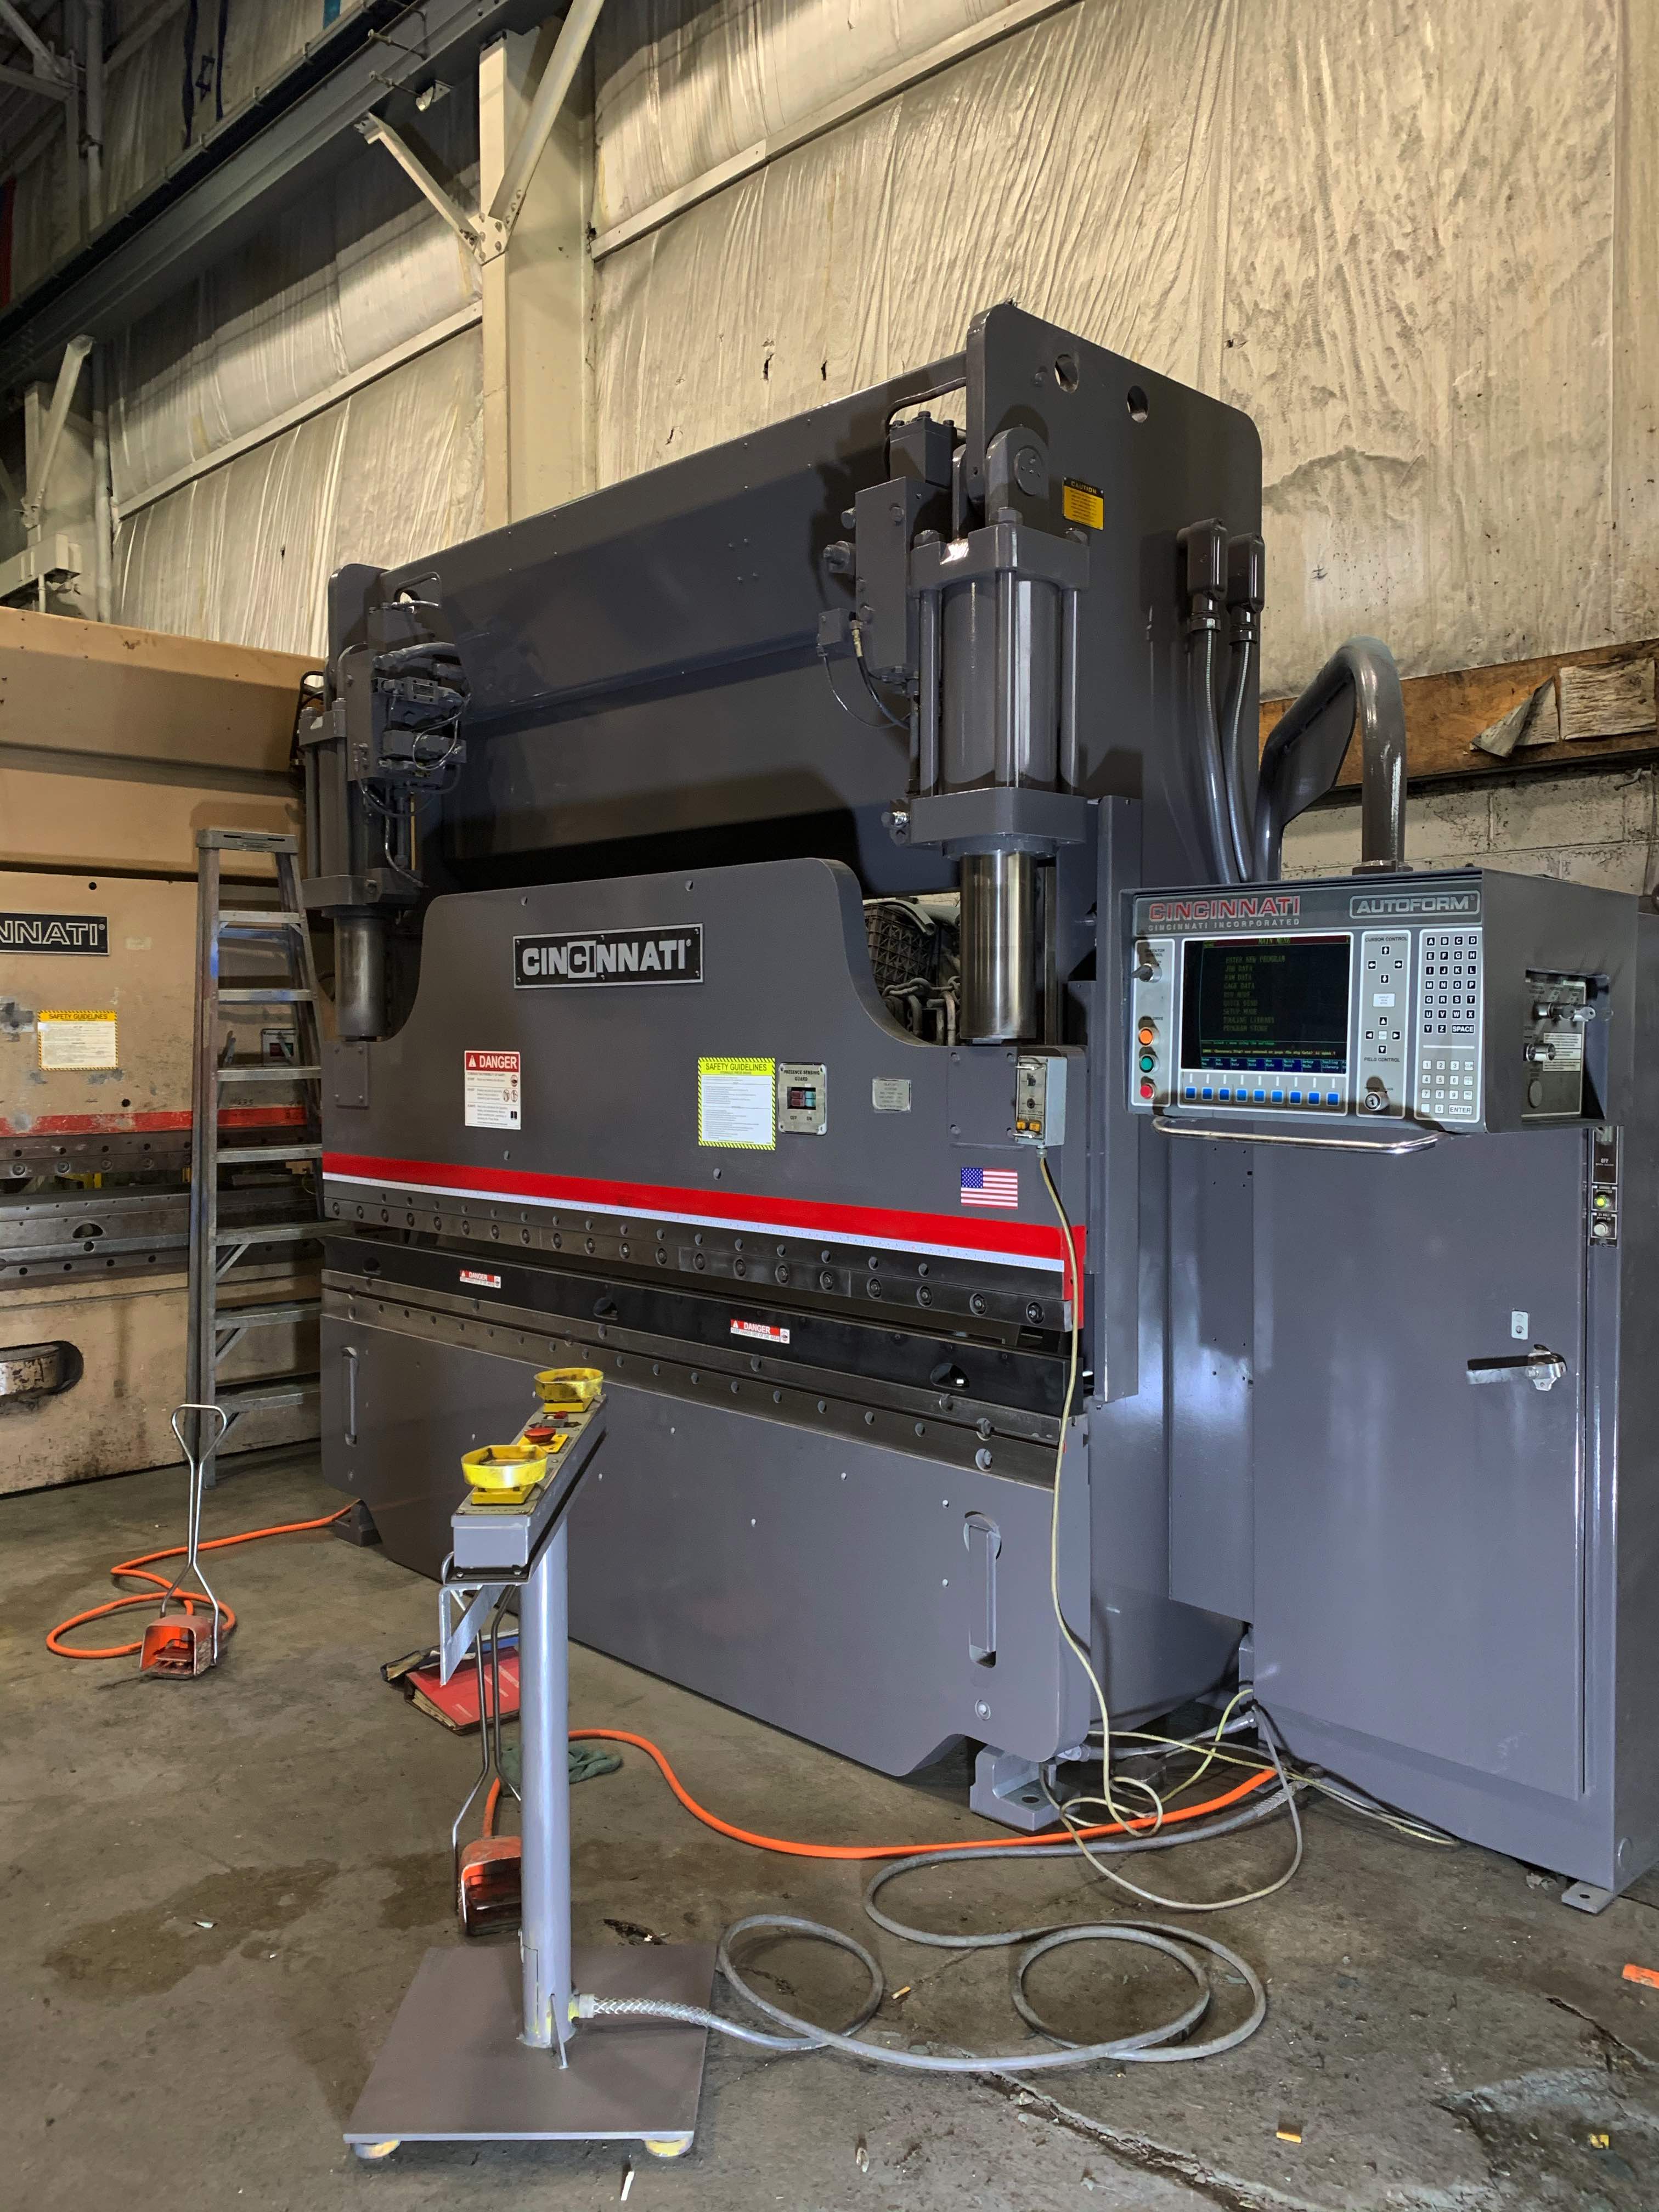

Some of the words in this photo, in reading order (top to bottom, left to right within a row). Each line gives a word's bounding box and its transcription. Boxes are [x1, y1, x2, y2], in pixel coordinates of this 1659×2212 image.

[1071, 481, 1097, 494] CAUTION
[1149, 895, 1301, 922] CINCINNATI
[1356, 895, 1469, 913] AUTOFORM
[1148, 922, 1207, 931] CINCINNATI
[1214, 919, 1300, 928] INCORPORATED
[522, 939, 685, 978] CINCINNATI
[479, 1055, 517, 1069] DANGER
[743, 1322, 770, 1334] DANGER
